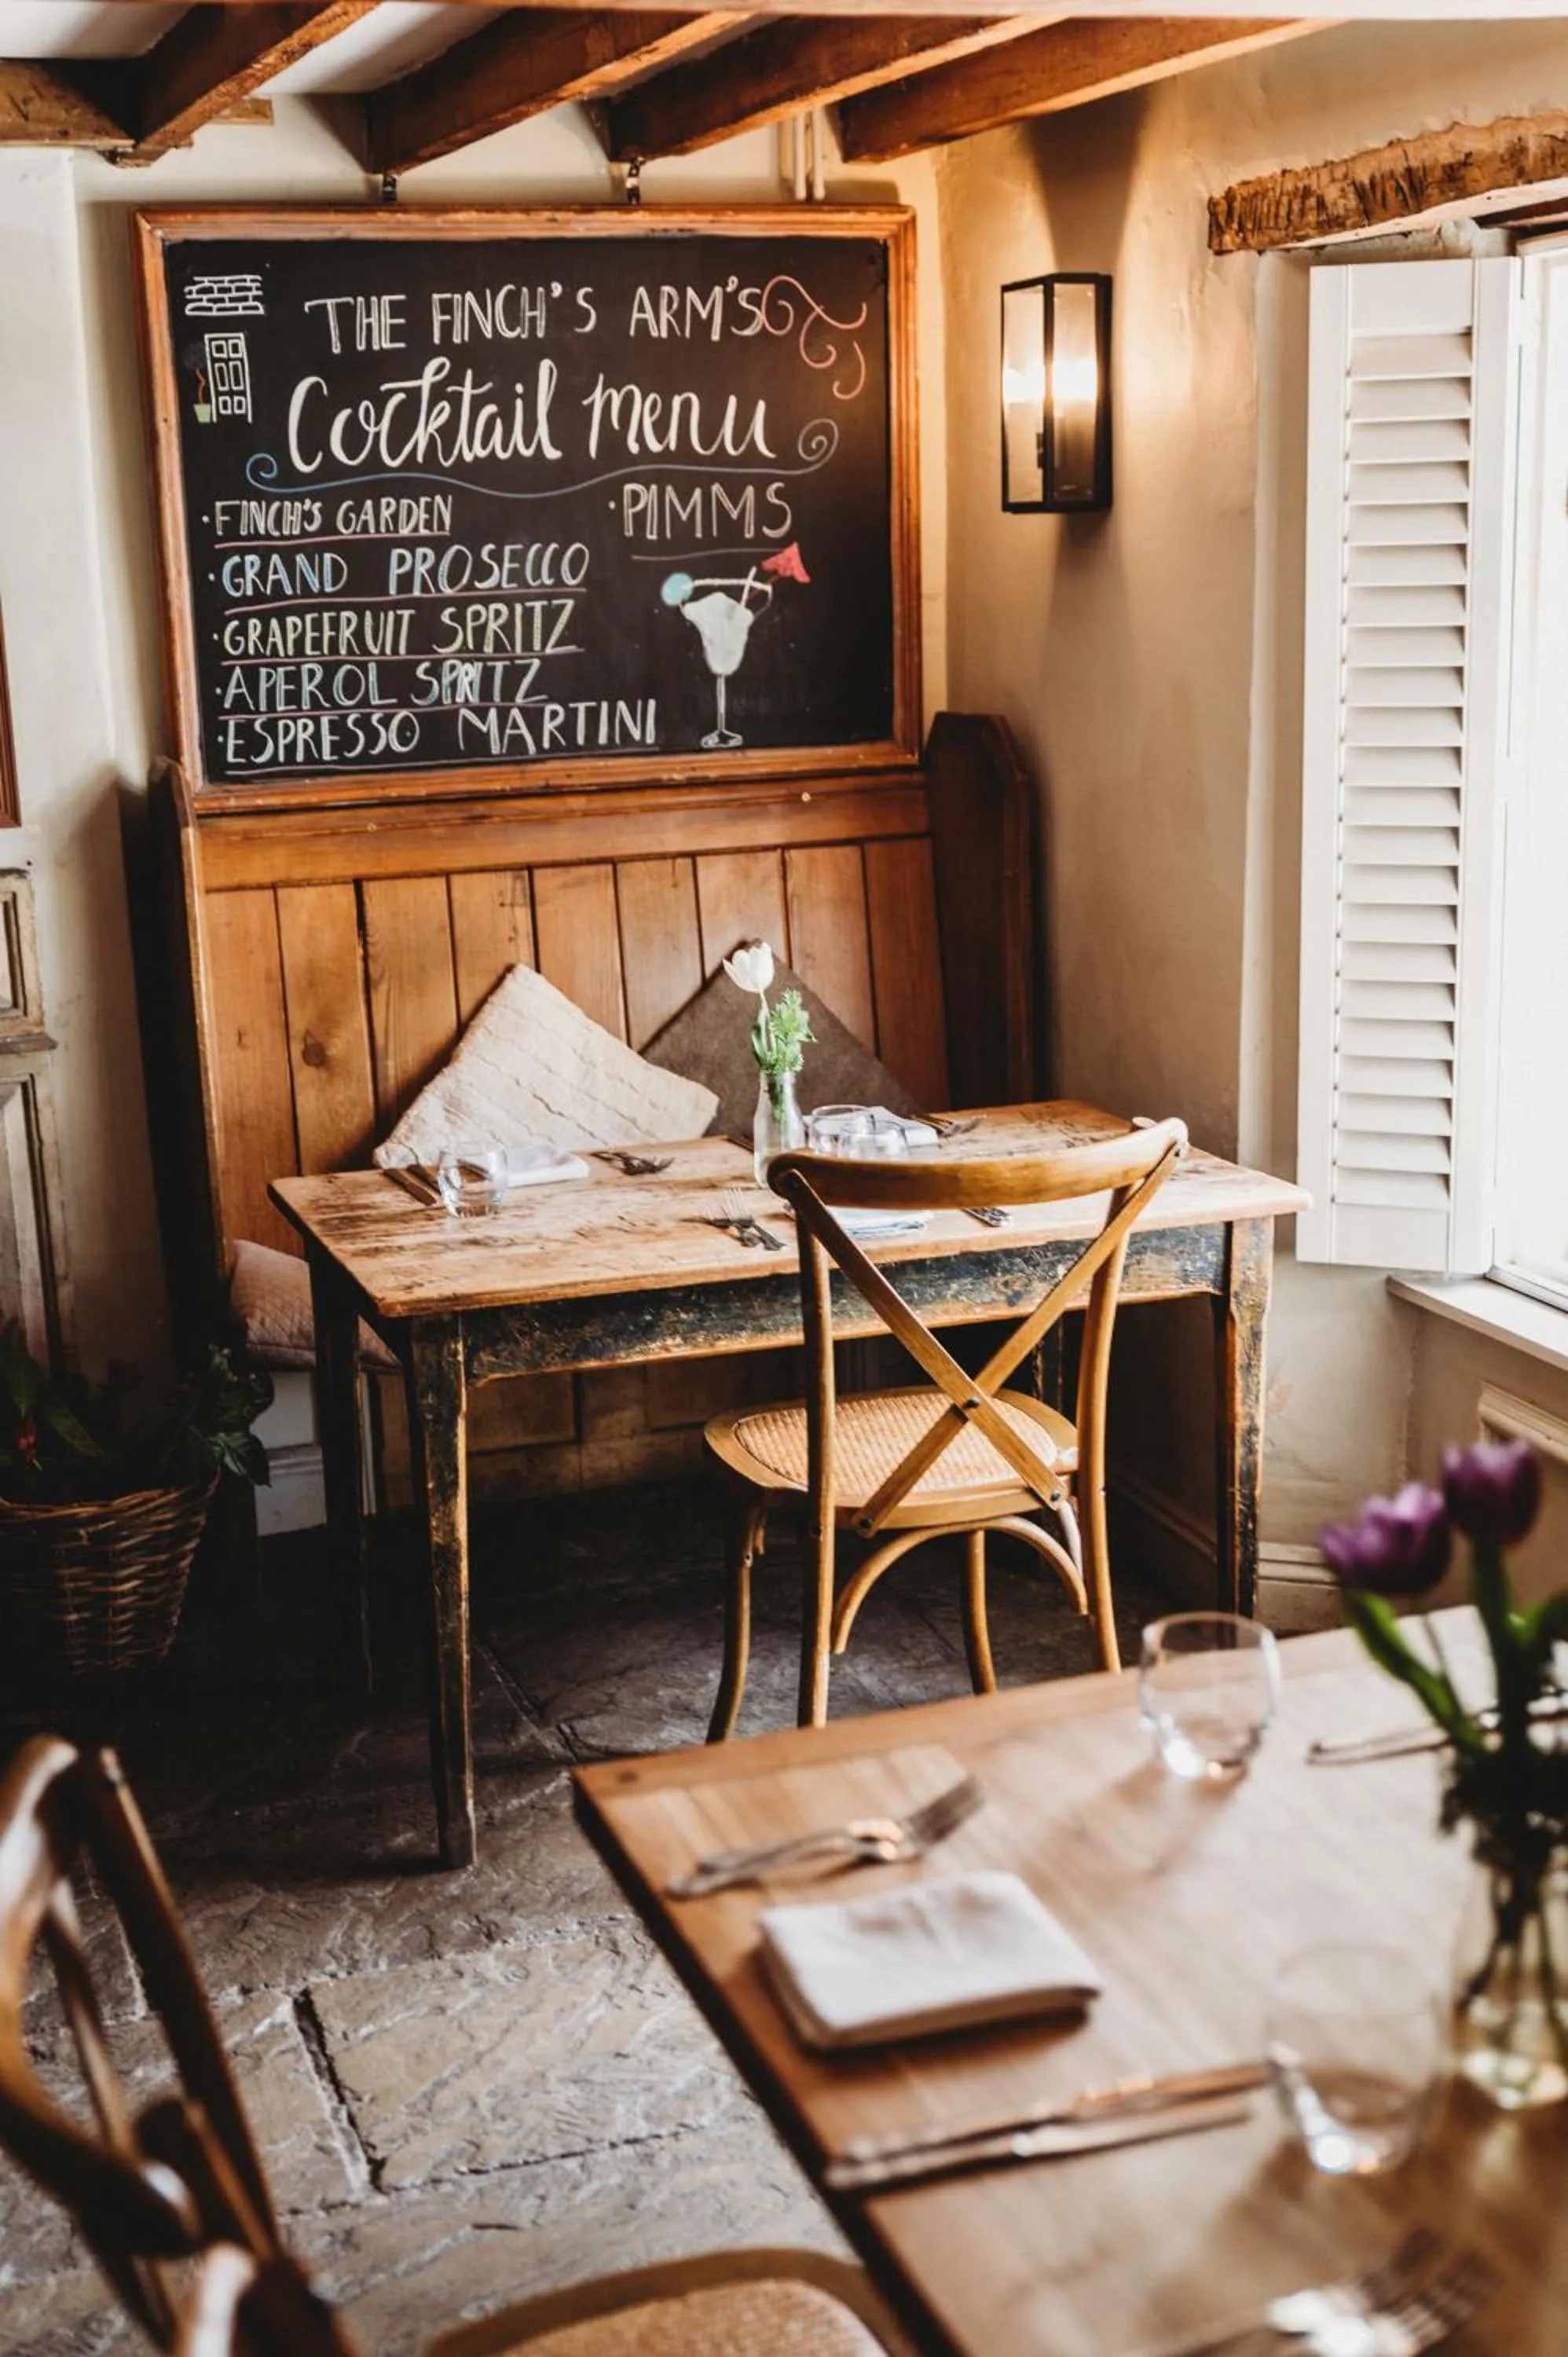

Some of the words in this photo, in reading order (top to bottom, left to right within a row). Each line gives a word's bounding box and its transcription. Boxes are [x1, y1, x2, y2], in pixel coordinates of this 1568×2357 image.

[304, 294, 406, 354] THE
[433, 281, 597, 345] FINCH'S
[629, 275, 764, 342] ARM'S
[288, 357, 562, 472] Cocktail
[215, 498, 322, 537] FINCH'S
[336, 494, 453, 535] GARDEN
[623, 482, 792, 540] PIMMS
[222, 552, 348, 598] GRAND
[389, 542, 590, 596] PROSECCO
[223, 610, 416, 657] GRAPEFRUIT
[432, 599, 578, 654] SPRITZ
[225, 662, 397, 713] APEROL
[411, 658, 548, 705] SPRITZ
[225, 710, 420, 764] ESPRESSO
[459, 698, 657, 756] MARTINI
